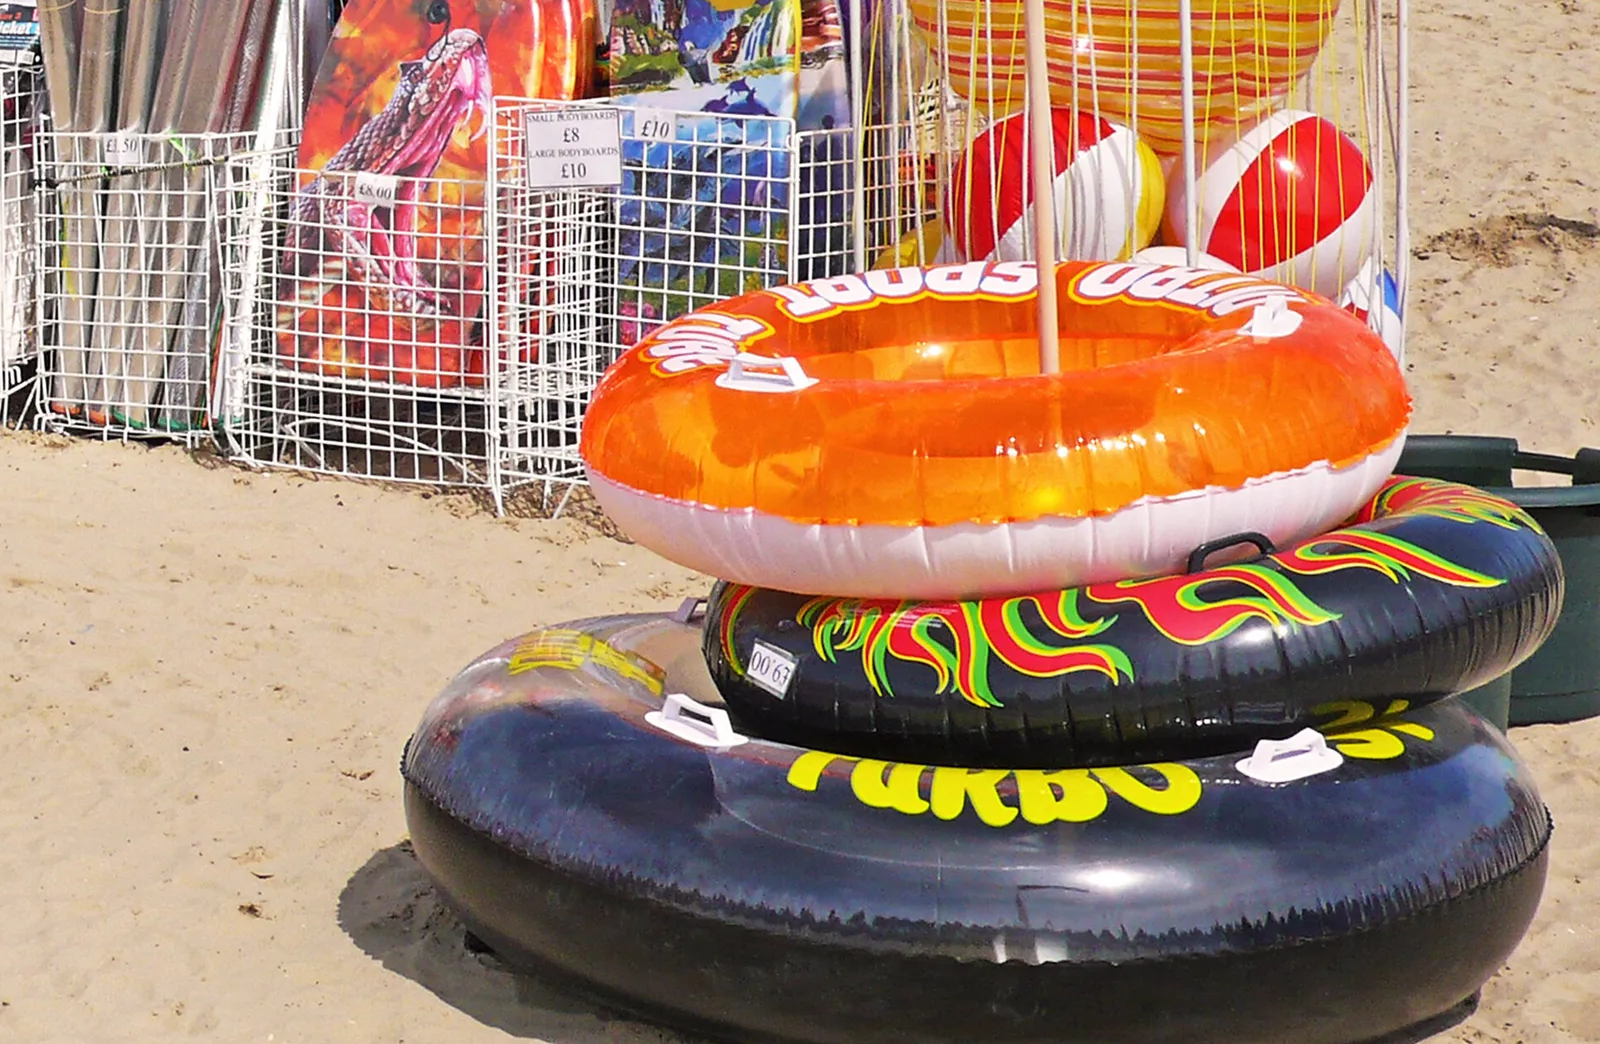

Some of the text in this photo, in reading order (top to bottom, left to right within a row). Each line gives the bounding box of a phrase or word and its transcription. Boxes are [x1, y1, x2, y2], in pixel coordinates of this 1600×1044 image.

[527, 113, 553, 123] SMALL
[563, 127, 580, 143] £8
[641, 120, 670, 138] £10
[529, 147, 618, 159] LARGE BODYBOARDS
[561, 163, 587, 179] £10
[782, 261, 1040, 317] SPORT
[752, 651, 790, 686] £9.00
